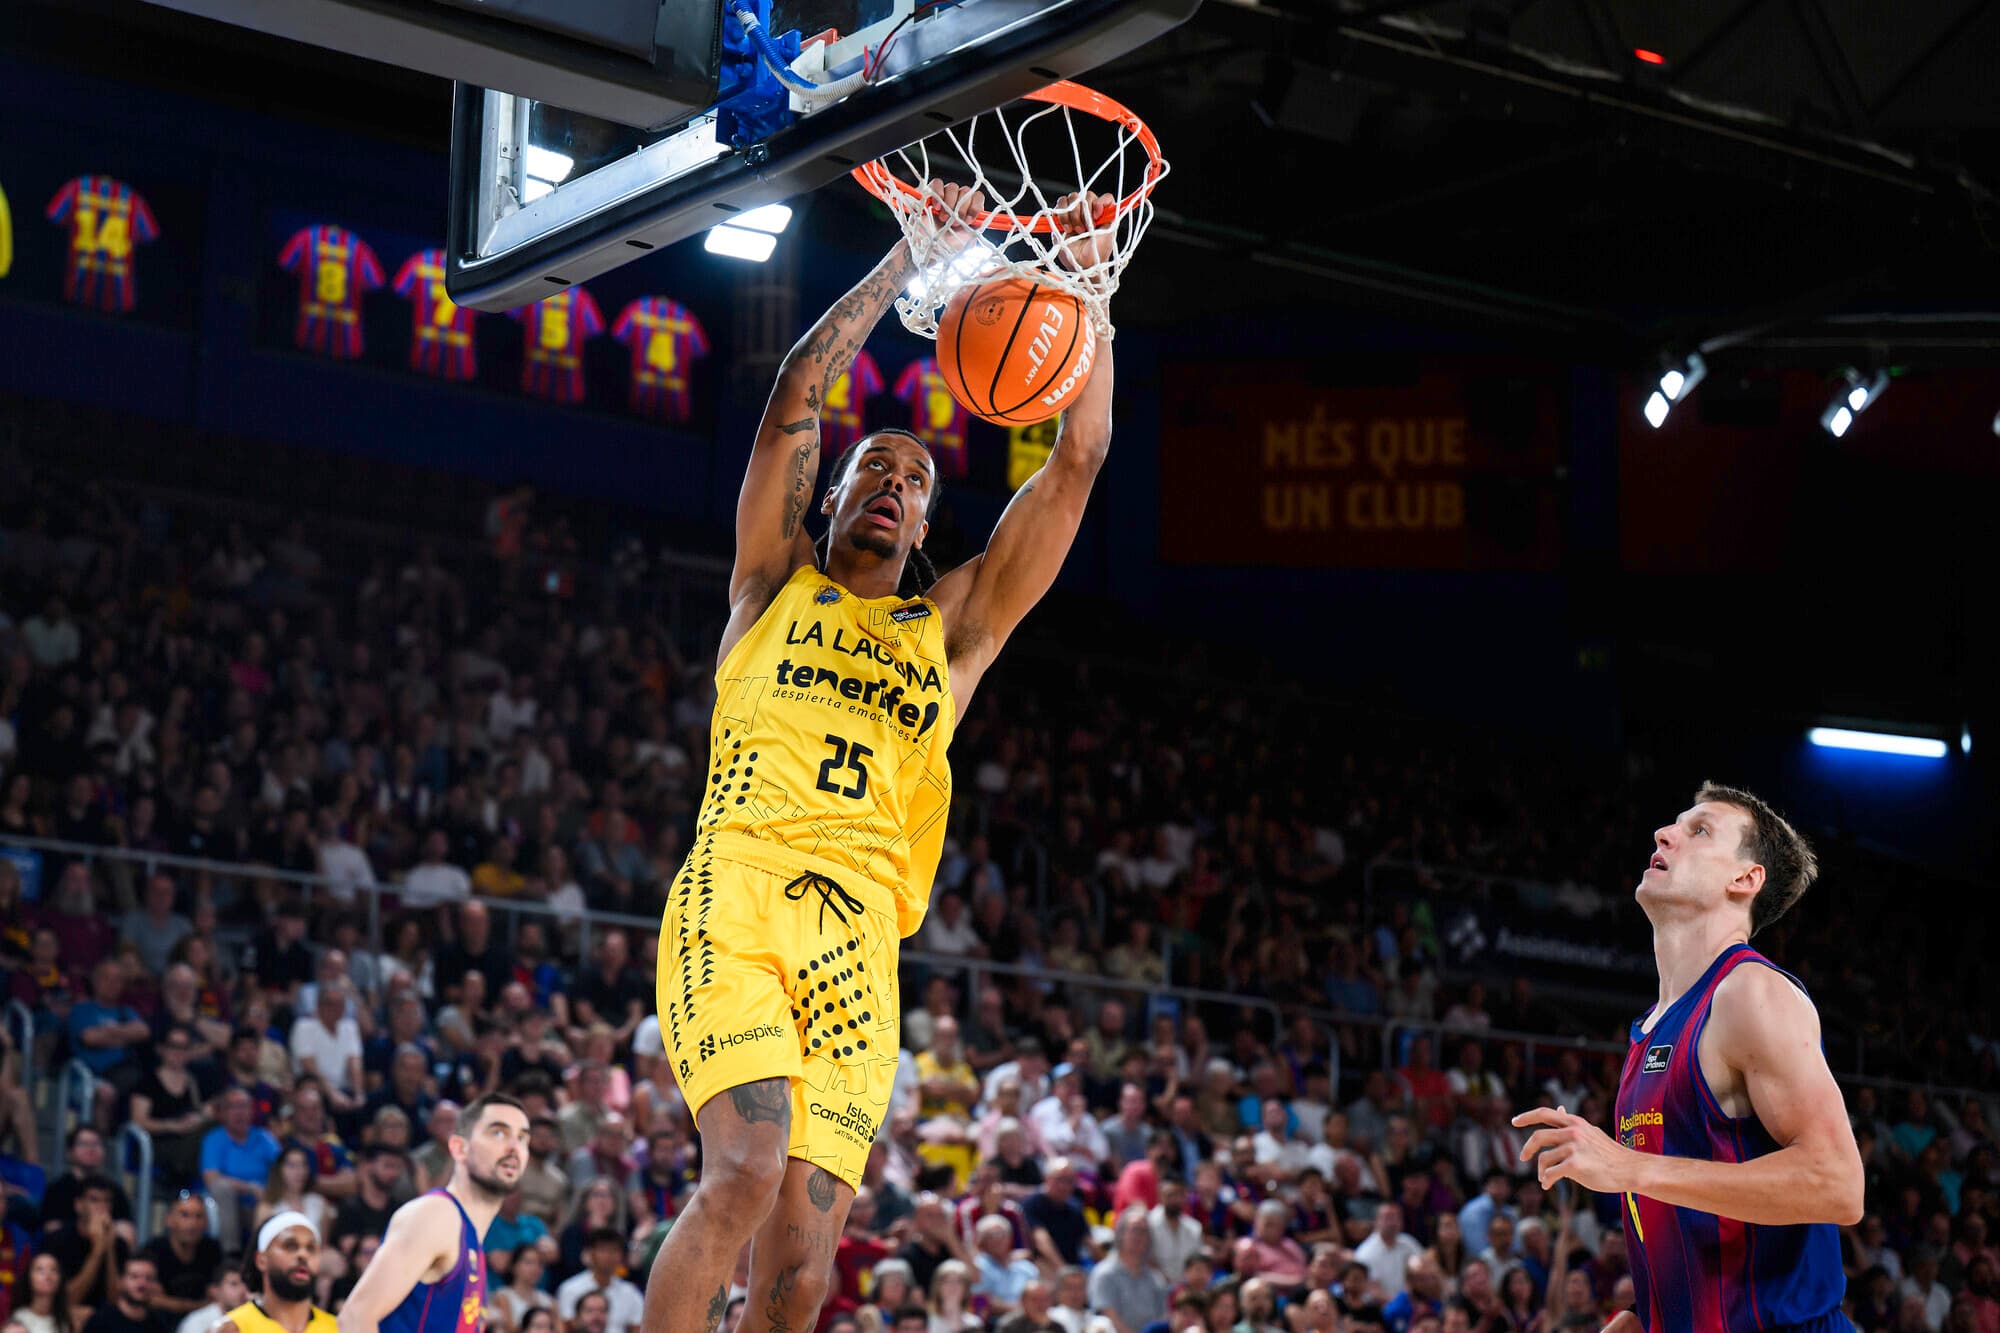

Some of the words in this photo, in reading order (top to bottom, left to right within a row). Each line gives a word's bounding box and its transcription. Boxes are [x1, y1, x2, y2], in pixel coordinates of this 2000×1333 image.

[74, 209, 131, 259] 14
[1264, 402, 1356, 467] MÉS
[1368, 416, 1467, 477] QUE
[1264, 482, 1330, 530] UN
[1346, 482, 1466, 529] CLUB
[786, 620, 824, 647] LA
[833, 628, 942, 694] LAGUNA
[772, 687, 842, 709] despierta
[848, 704, 911, 741] emociones
[816, 733, 874, 800] 25
[810, 1103, 870, 1141] Canarias
[846, 1102, 873, 1128] Islas
